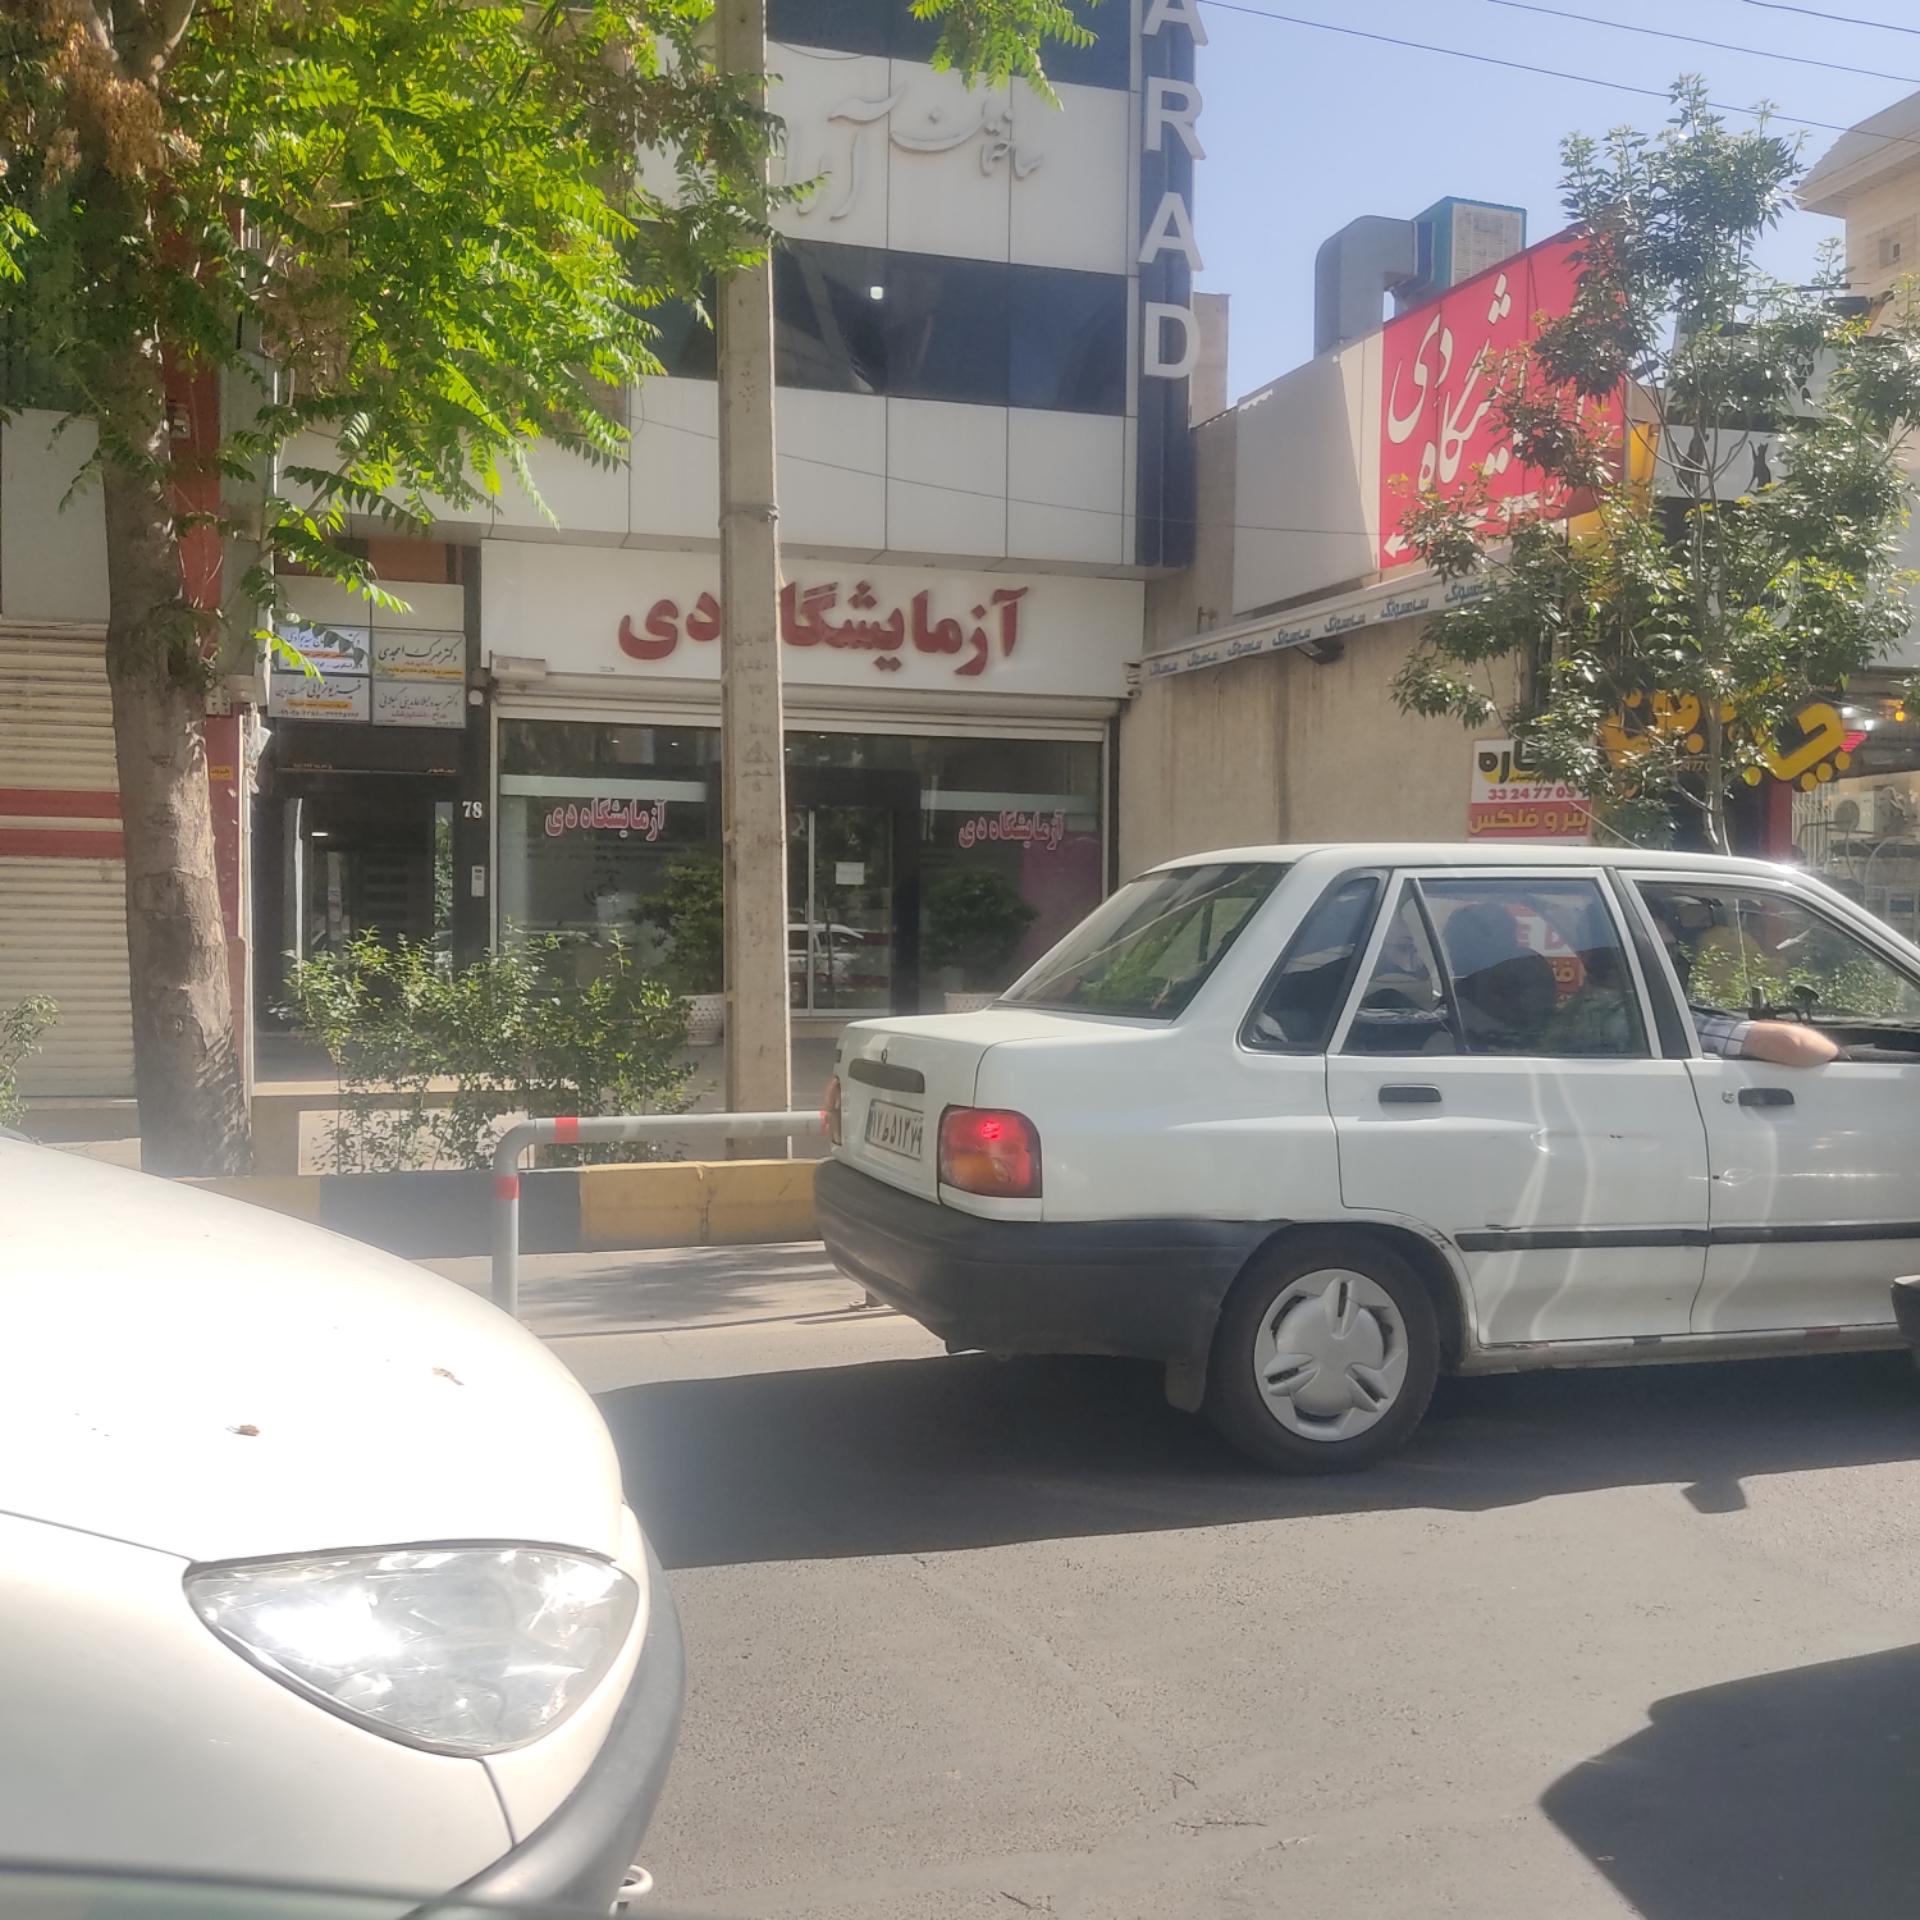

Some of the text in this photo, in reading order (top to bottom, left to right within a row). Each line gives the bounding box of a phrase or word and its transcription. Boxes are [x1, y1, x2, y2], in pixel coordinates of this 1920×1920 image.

[1138, 0, 1209, 380] ARAD
[618, 580, 1029, 676] آزمایشگا دی
[462, 801, 483, 819] 78
[545, 797, 667, 841] آزمایشگاه دی
[988, 808, 1066, 851] آزمایشگاه
[1470, 807, 1540, 834] فلکس
